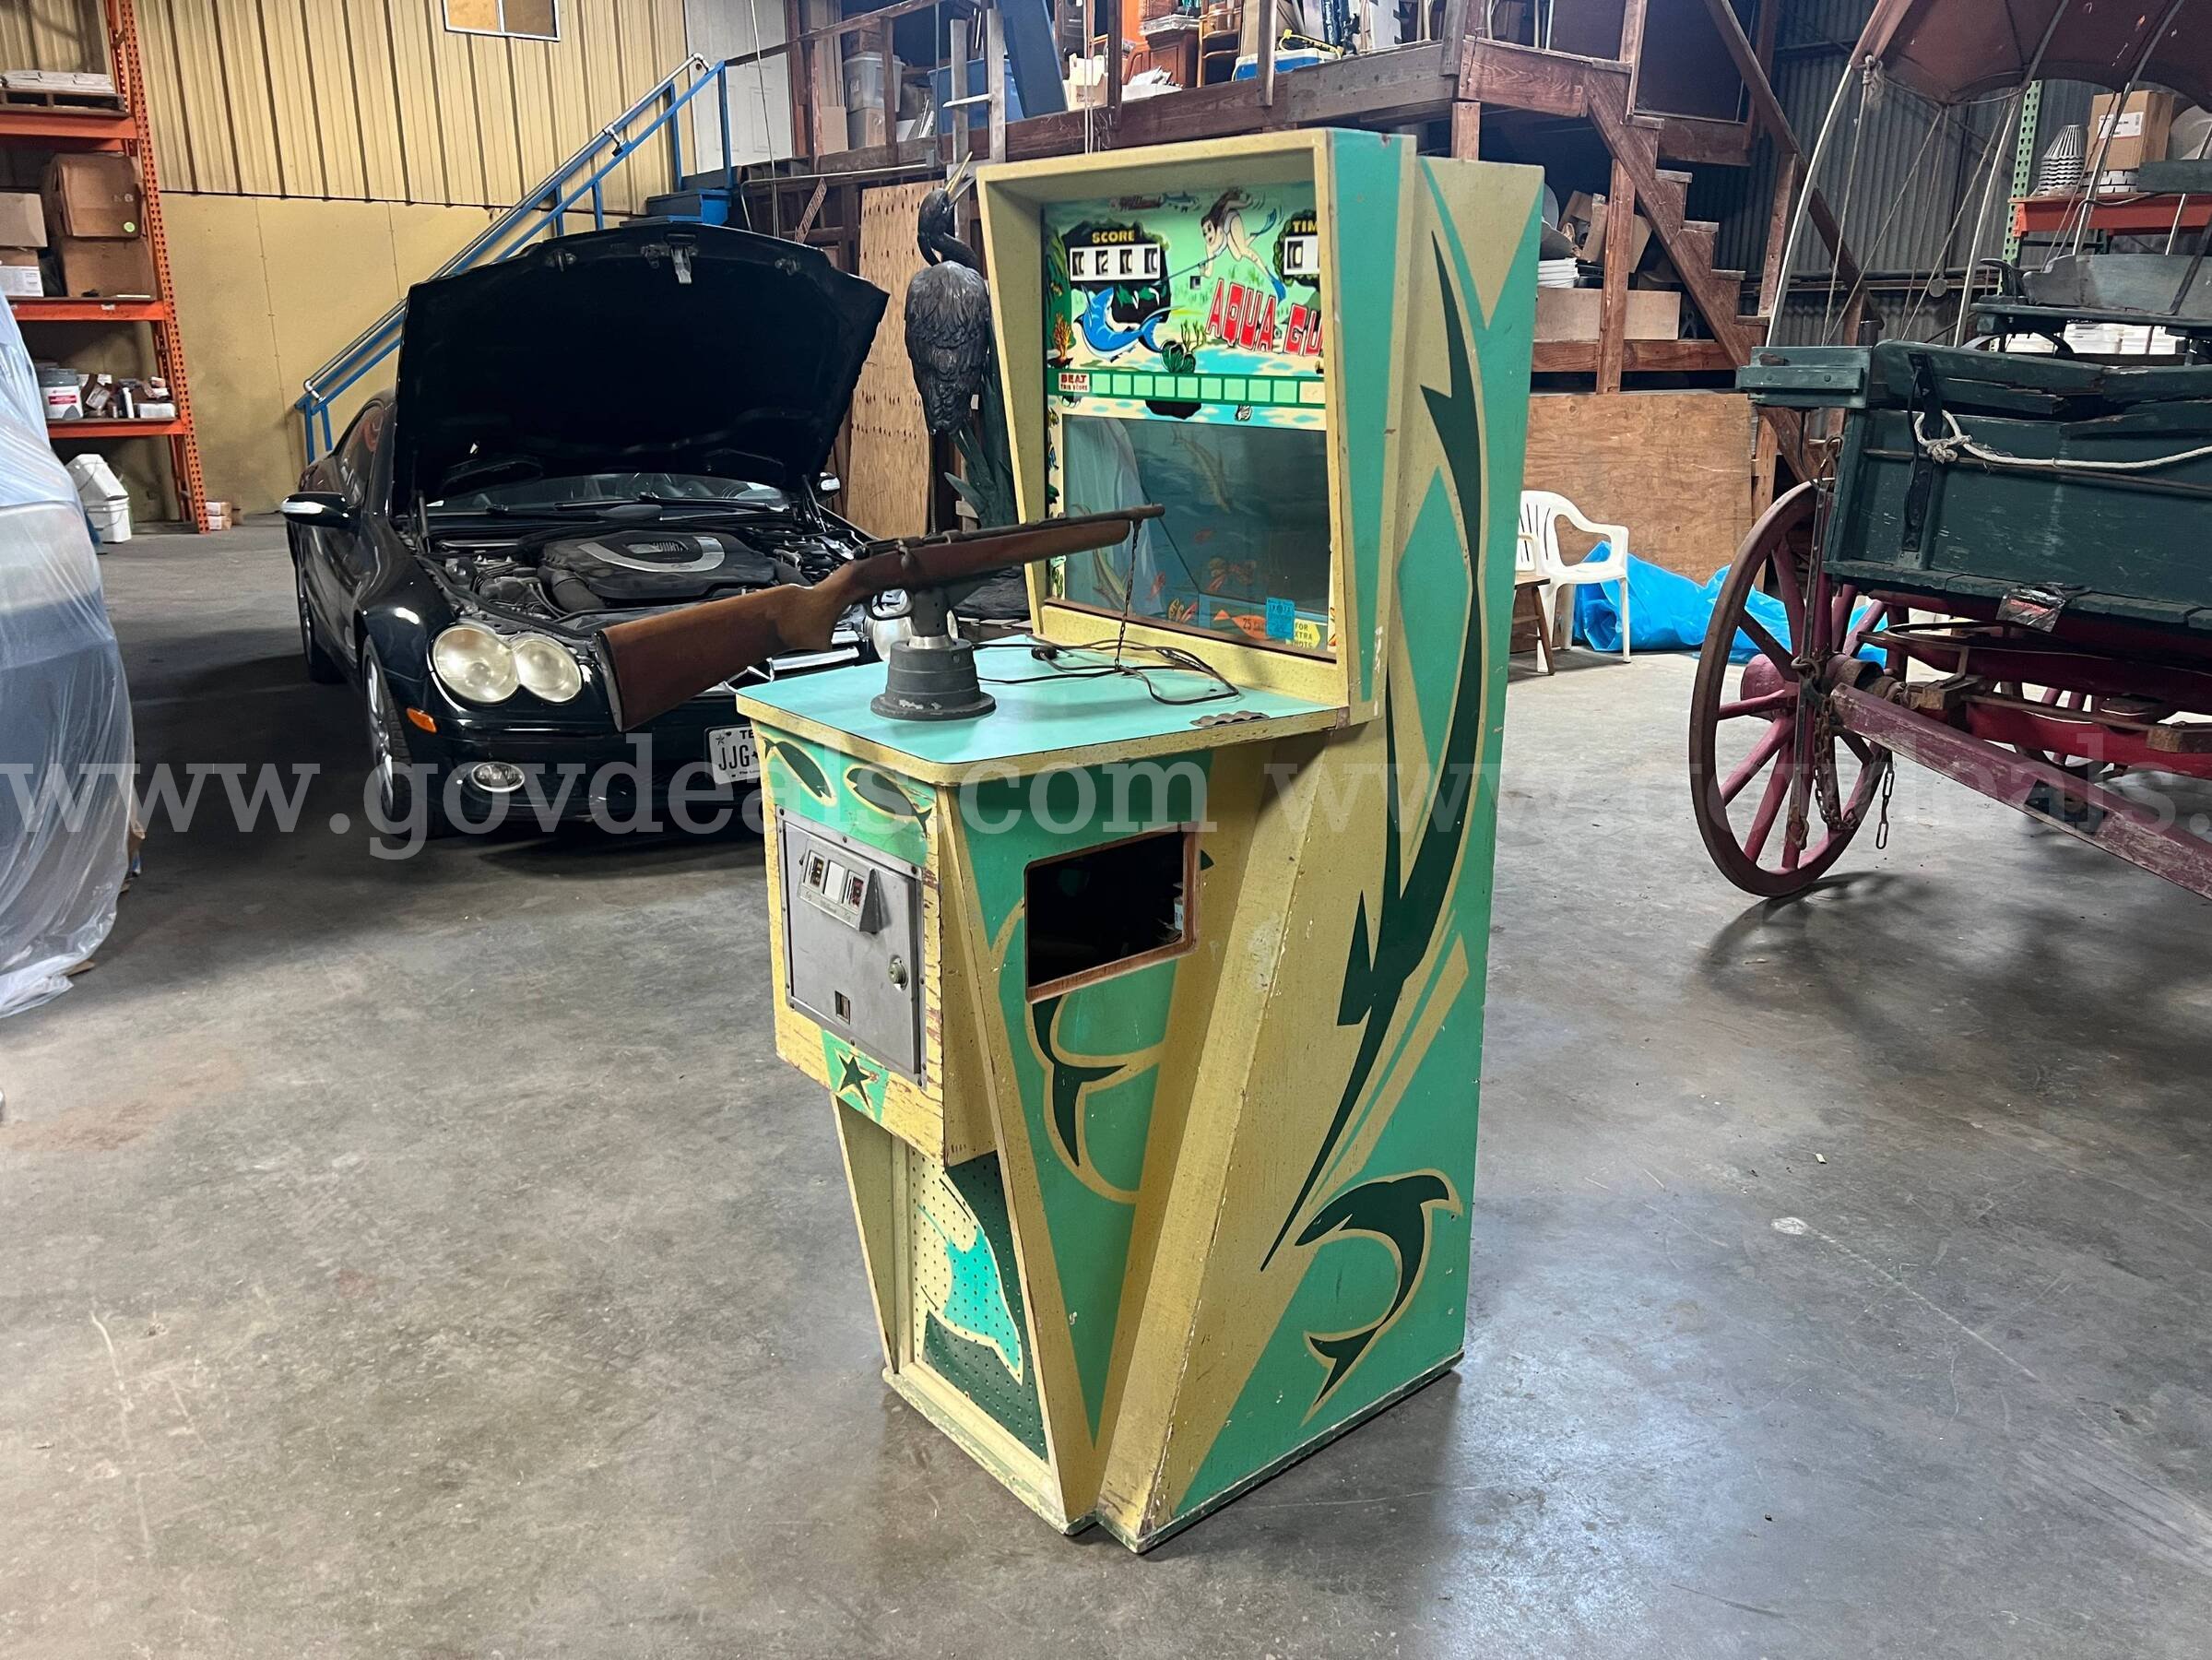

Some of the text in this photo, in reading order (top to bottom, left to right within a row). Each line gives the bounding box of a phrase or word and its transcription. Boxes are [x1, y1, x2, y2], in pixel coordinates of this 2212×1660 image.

[1092, 230, 1135, 243] SCORE
[1205, 277, 1277, 352] AQUA
[1060, 374, 1087, 384] BEAT
[1243, 618, 1252, 631] 25
[1294, 631, 1313, 642] XTRA
[718, 744, 750, 771] JJG
